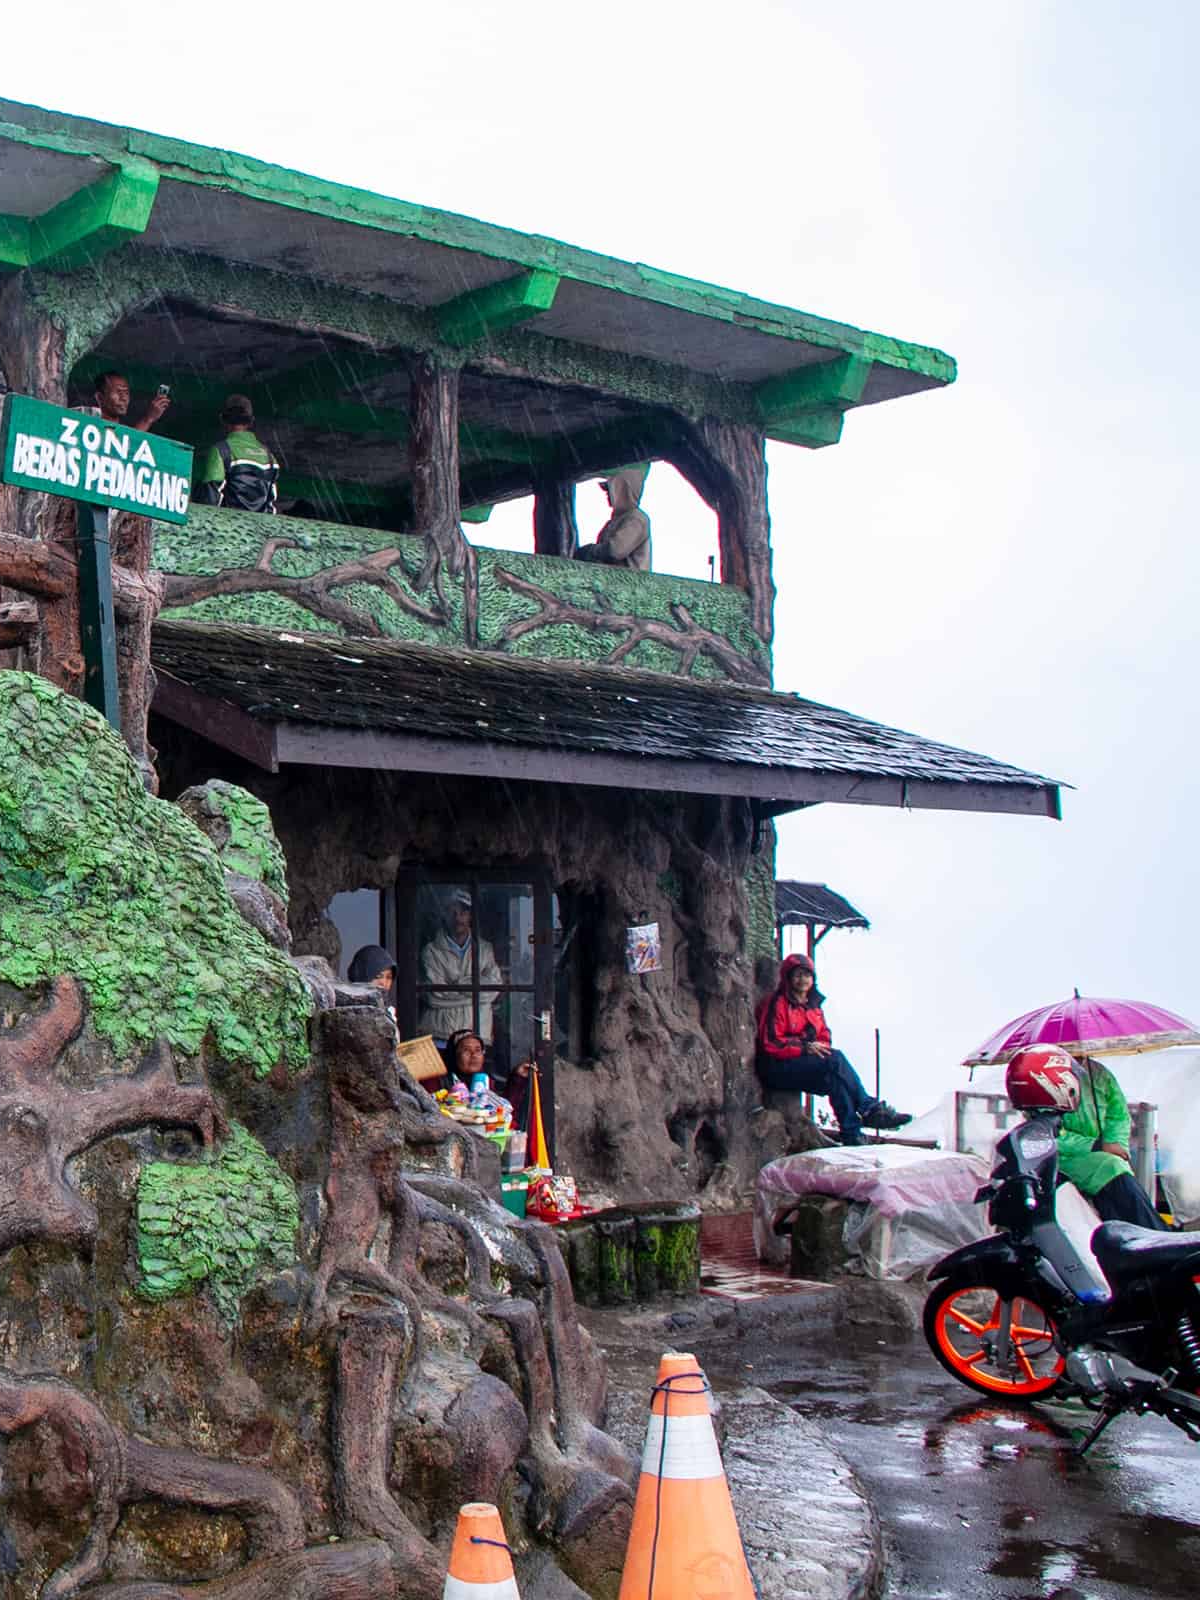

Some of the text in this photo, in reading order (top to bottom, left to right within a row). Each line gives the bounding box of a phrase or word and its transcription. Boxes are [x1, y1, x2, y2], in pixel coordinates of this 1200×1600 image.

[13, 433, 189, 514] BEBAS PEDAGANG
[60, 417, 156, 467] ZONA
